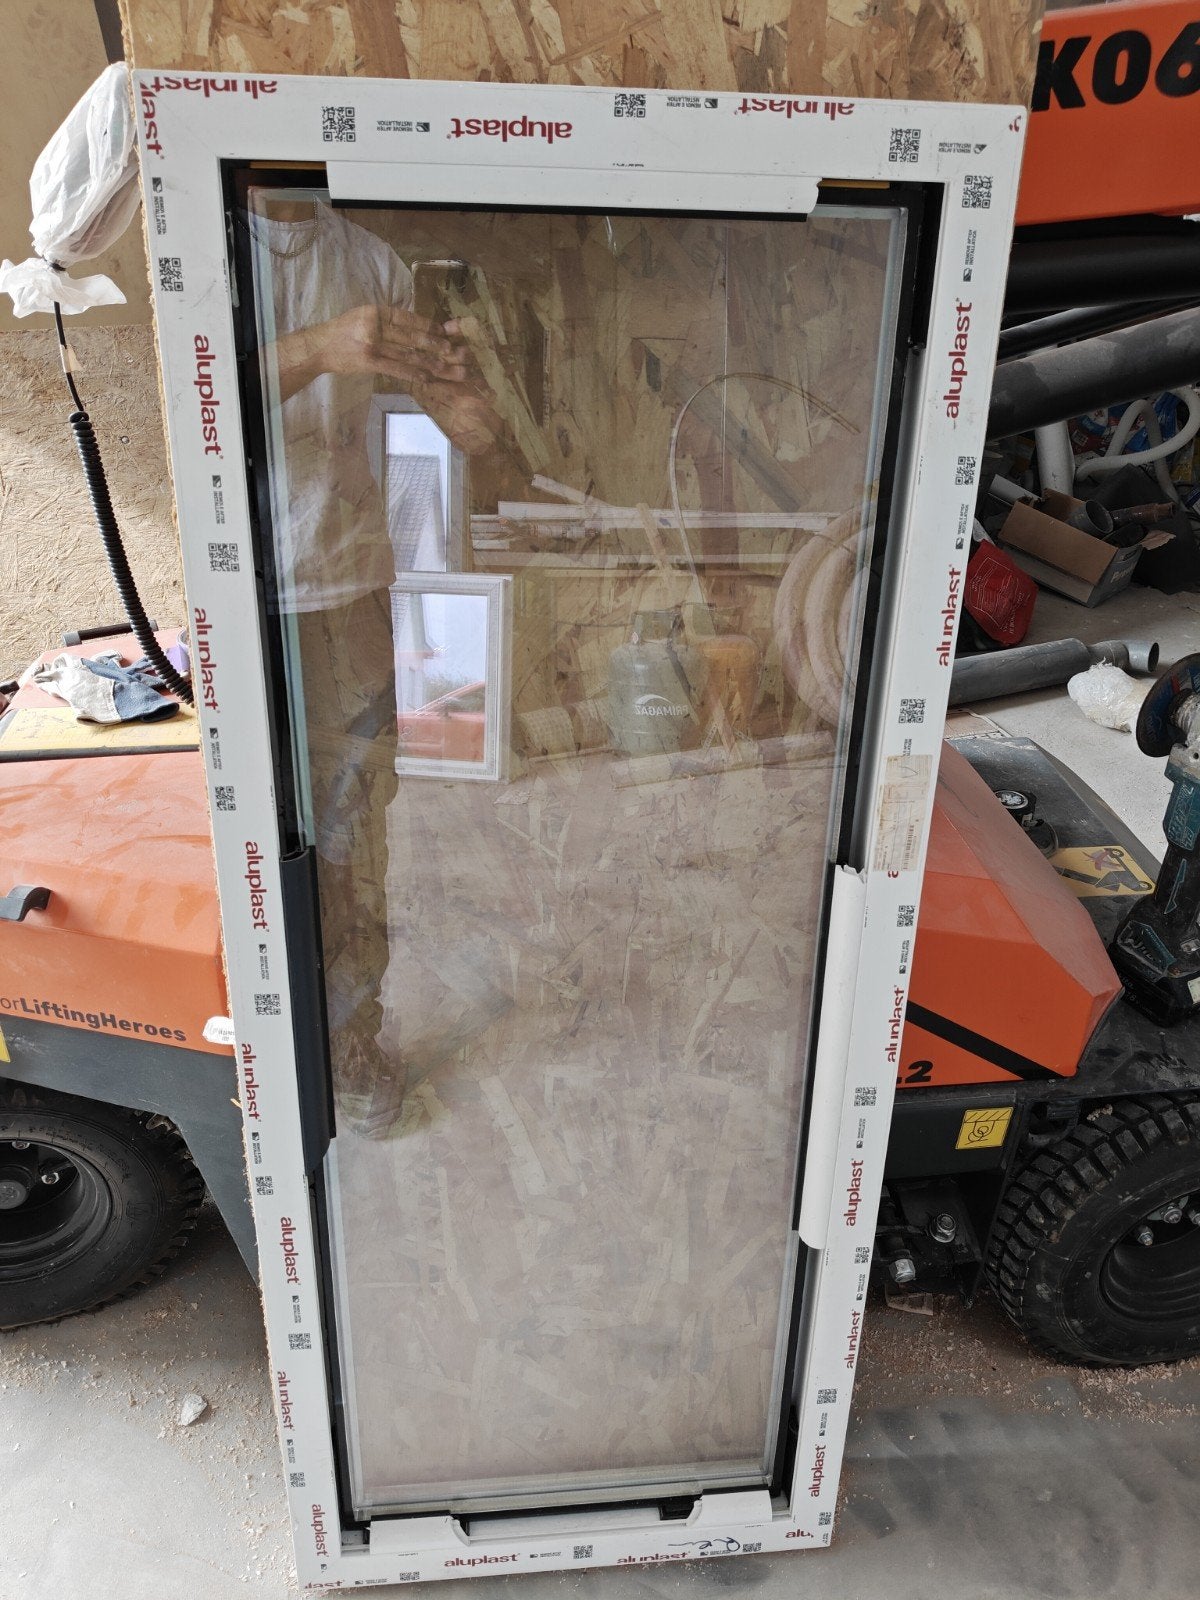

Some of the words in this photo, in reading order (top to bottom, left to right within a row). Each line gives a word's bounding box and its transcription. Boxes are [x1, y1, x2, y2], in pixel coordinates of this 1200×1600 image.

[451, 115, 573, 144] aluplast
[943, 302, 972, 419] aluplast
[194, 334, 220, 455] aluplast
[245, 841, 269, 929] aluplast
[844, 1160, 864, 1226] aluplast
[280, 1216, 299, 1284] aluplast
[808, 1445, 826, 1497] aluplast
[312, 1504, 328, 1556] aluplast
[444, 1554, 518, 1568] aluplast
